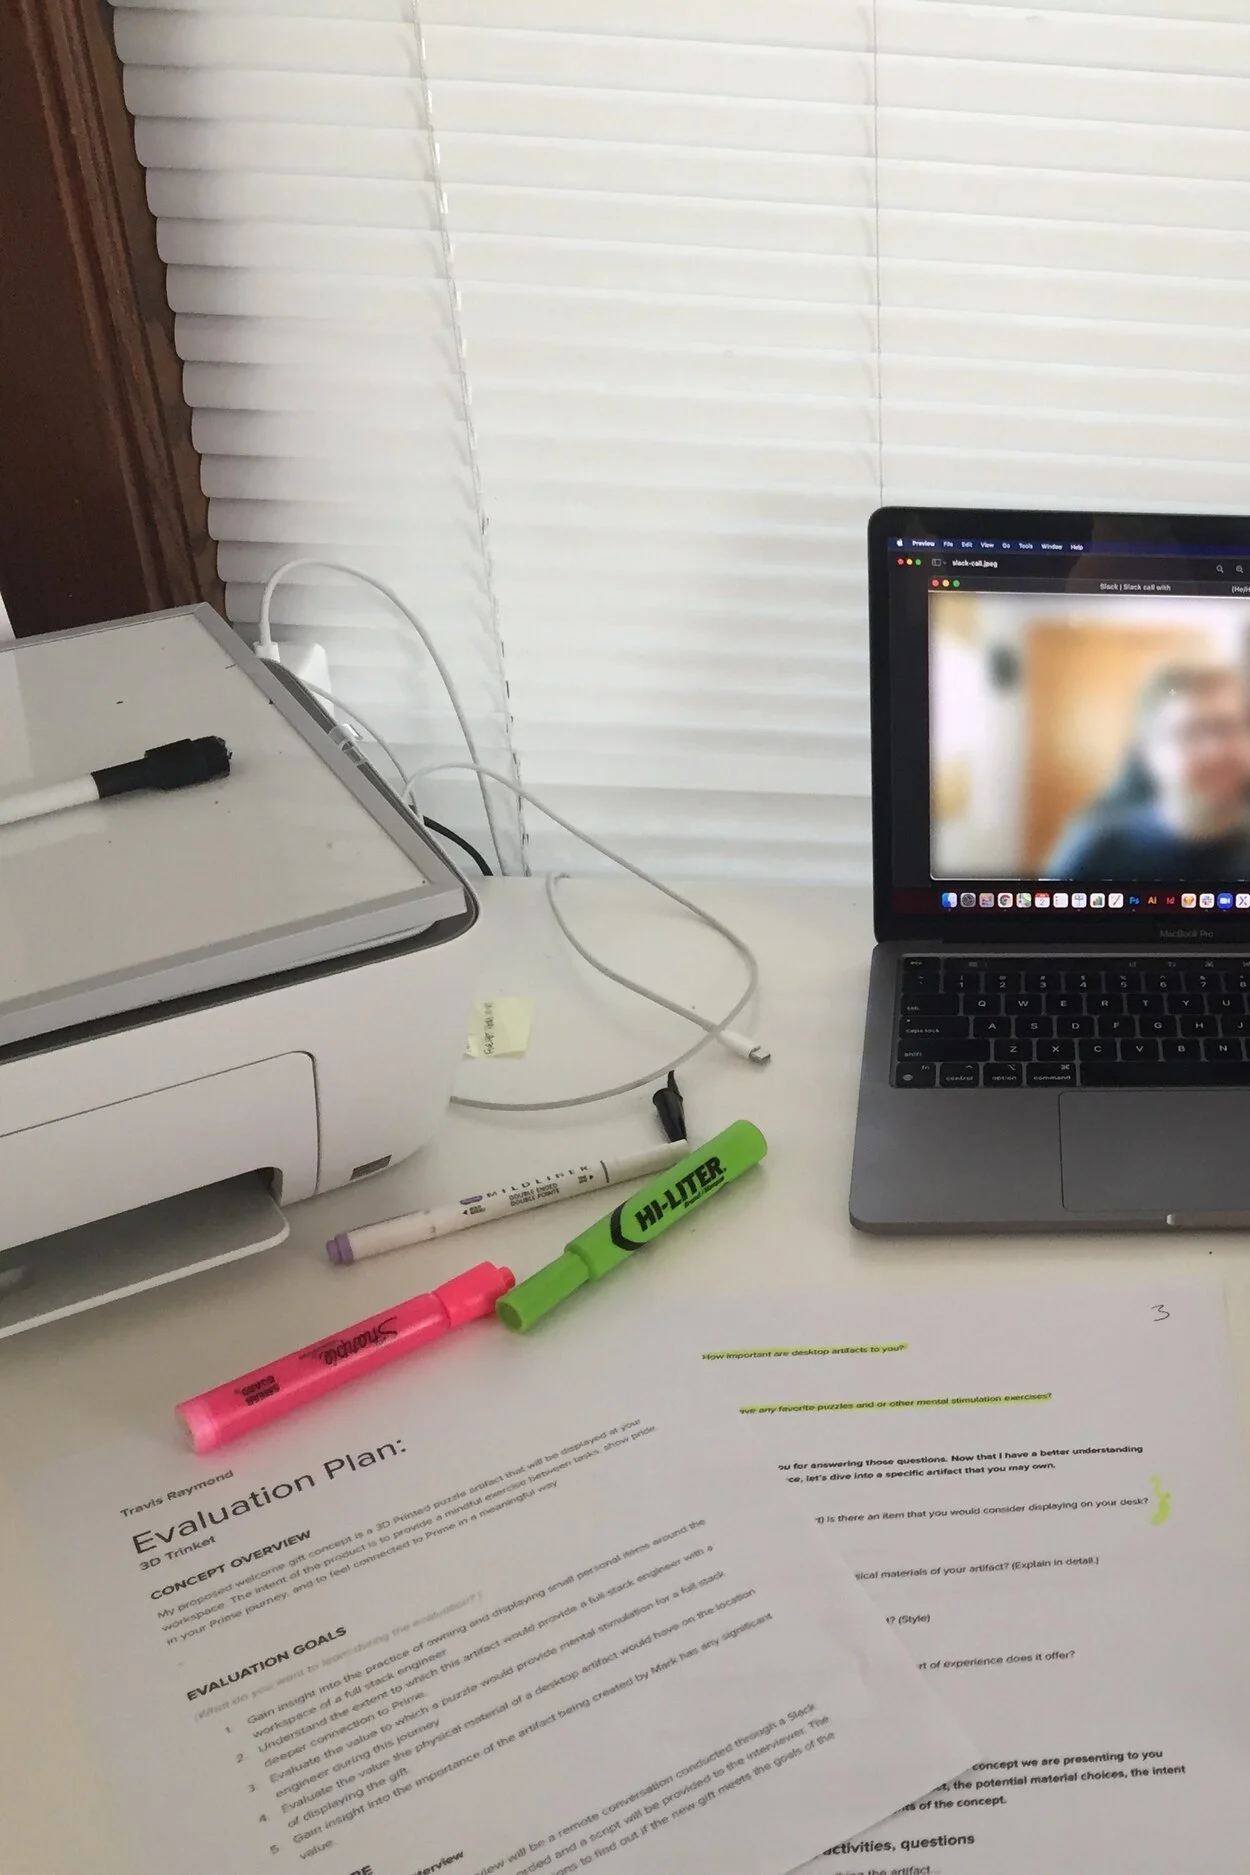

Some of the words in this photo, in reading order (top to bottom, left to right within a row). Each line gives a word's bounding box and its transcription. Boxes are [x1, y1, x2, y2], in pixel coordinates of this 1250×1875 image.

[1041, 543, 1063, 551] Window
[1100, 583, 1118, 591] Slack
[1123, 583, 1142, 591] Slack
[1157, 584, 1171, 592] with
[1159, 929, 1198, 938] MacBook
[1200, 929, 1214, 938] Pro
[1151, 1304, 1171, 1322] 3
[319, 1316, 398, 1367] Sharpie
[727, 1350, 771, 1361] important
[791, 1348, 829, 1357] desktop
[832, 1345, 868, 1355] artifacts
[882, 1344, 905, 1354] you?
[793, 1461, 808, 1470] for
[810, 1458, 864, 1470] answering
[865, 1458, 895, 1466] those
[897, 1455, 948, 1466] questions.
[951, 1454, 974, 1462] Now
[976, 1452, 997, 1460] that
[1005, 1451, 1029, 1459] have
[1040, 1448, 1070, 1457] better
[1072, 1444, 1143, 1456] understanding
[806, 1474, 828, 1482] let's
[885, 1469, 924, 1479] specific
[926, 1467, 962, 1476] artifact
[965, 1466, 985, 1474] that
[987, 1466, 1006, 1475] you
[1008, 1464, 1030, 1473] may
[1032, 1462, 1056, 1470] own.
[120, 1498, 164, 1517] Travis
[167, 1470, 234, 1501] Raymond
[132, 1474, 315, 1553] Evaluation
[323, 1439, 407, 1480] Plan:
[838, 1513, 865, 1522] there
[883, 1511, 905, 1520] item
[907, 1510, 926, 1518] that
[929, 1510, 948, 1520] you
[950, 1507, 980, 1517] would
[983, 1505, 1026, 1515] consider
[1028, 1501, 1078, 1512] displaying
[1096, 1500, 1117, 1509] your
[1120, 1497, 1148, 1506] desk?
[140, 1557, 161, 1571] 3D
[165, 1535, 216, 1561] Trinket
[150, 1564, 226, 1600] CONCEPT
[231, 1530, 311, 1568] OVERVIEW
[898, 1613, 931, 1625] (Style)
[187, 1651, 290, 1701] EVALUATION
[293, 1626, 347, 1655] GOALS
[930, 1660, 940, 1669] of
[943, 1656, 1003, 1668] experience
[1006, 1653, 1032, 1663] does
[1045, 1650, 1075, 1660] offer?
[293, 1824, 322, 1844] Gain
[325, 1805, 365, 1830] insight
[367, 1792, 390, 1809] into
[392, 1783, 413, 1797] the
[415, 1750, 481, 1787] importance
[483, 1743, 495, 1755] of
[497, 1735, 516, 1748] the
[518, 1715, 557, 1738] artifact
[557, 1698, 590, 1718] being
[592, 1678, 633, 1702] created
[634, 1671, 649, 1684] by
[650, 1657, 678, 1674] Mark
[679, 1648, 699, 1661] has
[700, 1638, 720, 1652] any
[722, 1612, 773, 1642] significant
[972, 1759, 1018, 1771] concept
[1021, 1759, 1039, 1768] we
[1041, 1758, 1061, 1766] are
[1063, 1751, 1124, 1766] presenting
[1127, 1751, 1139, 1760] to
[1141, 1750, 1163, 1761] you
[900, 1833, 975, 1851] questions
